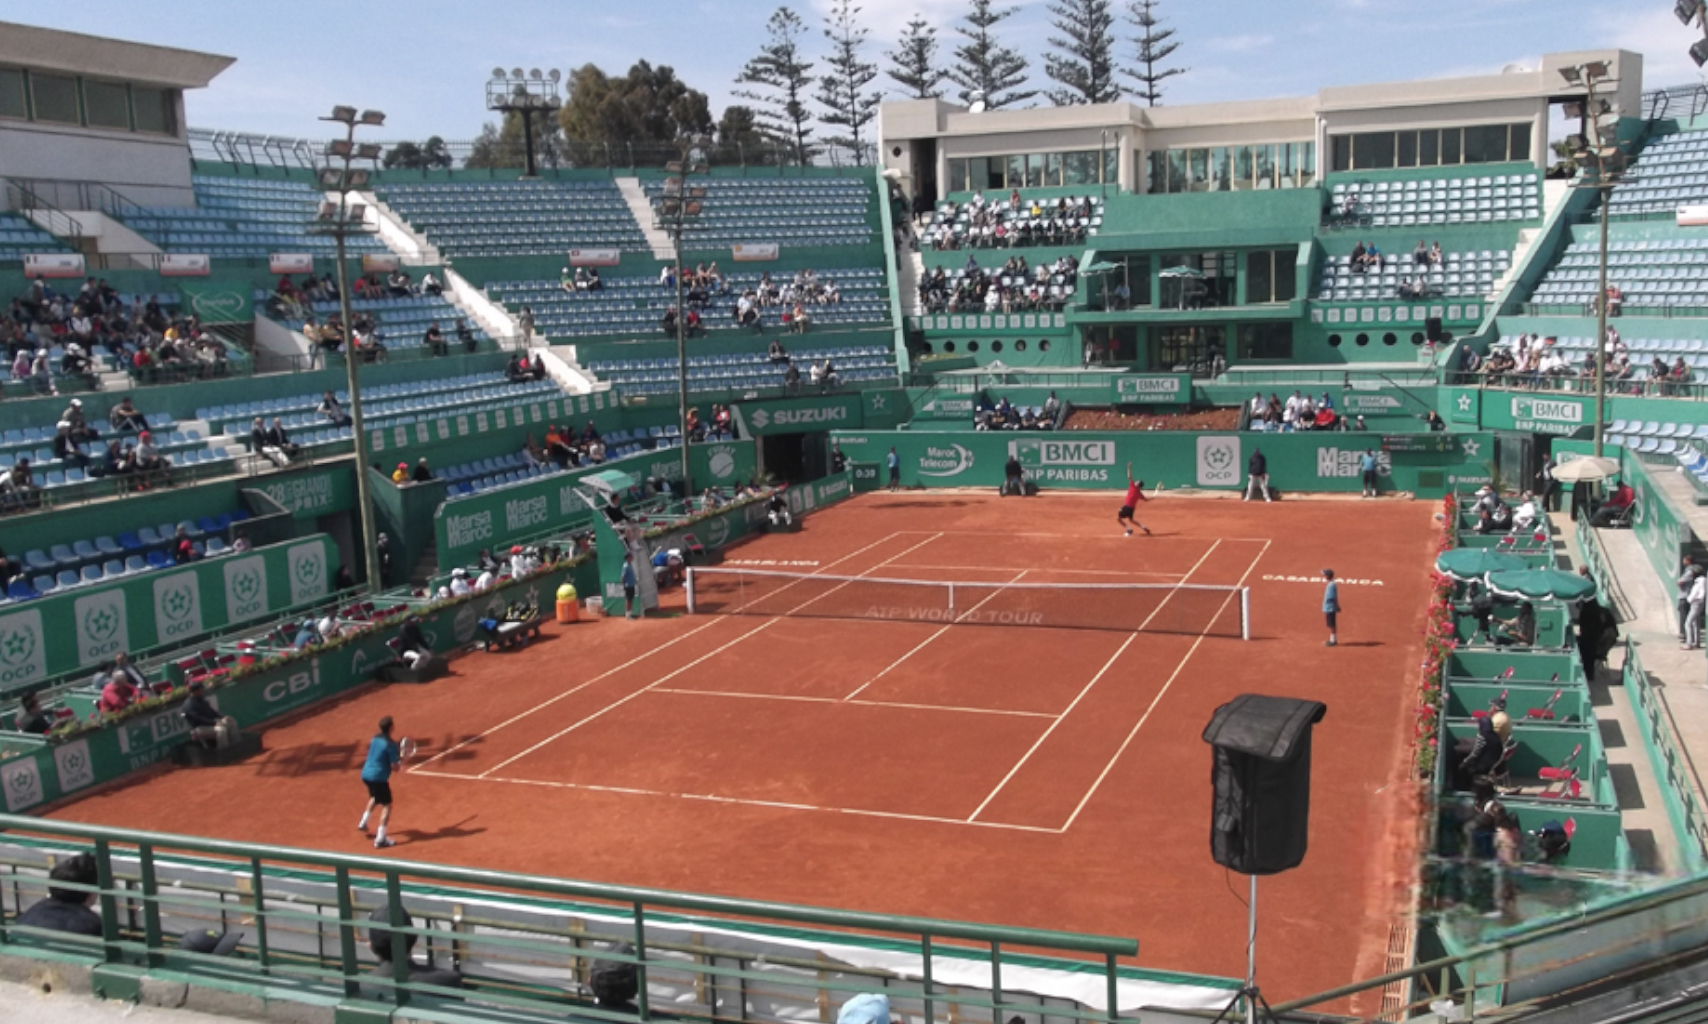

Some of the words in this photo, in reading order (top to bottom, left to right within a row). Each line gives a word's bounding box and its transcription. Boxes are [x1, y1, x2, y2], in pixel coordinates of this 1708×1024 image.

[1140, 380, 1175, 390] BMCI
[773, 406, 847, 425] SUZUKI
[1536, 402, 1577, 419] BMCI
[927, 446, 957, 458] Maroc
[1046, 443, 1106, 462] BMCI
[920, 457, 958, 468] Telecom
[1317, 462, 1392, 477] Marc
[1047, 468, 1108, 481] PARIBAS
[1206, 471, 1231, 480] OCP
[505, 495, 547, 517] Marsa
[446, 510, 491, 533] Marsa
[507, 508, 548, 532] Maroc
[448, 524, 493, 549] Maroc
[298, 585, 321, 599] OCP
[236, 601, 260, 616] OCP
[984, 610, 1044, 624] TOUR
[166, 620, 194, 636] OCP
[88, 641, 119, 658] OCP
[2, 664, 36, 682] OCP
[155, 711, 189, 739] BM
